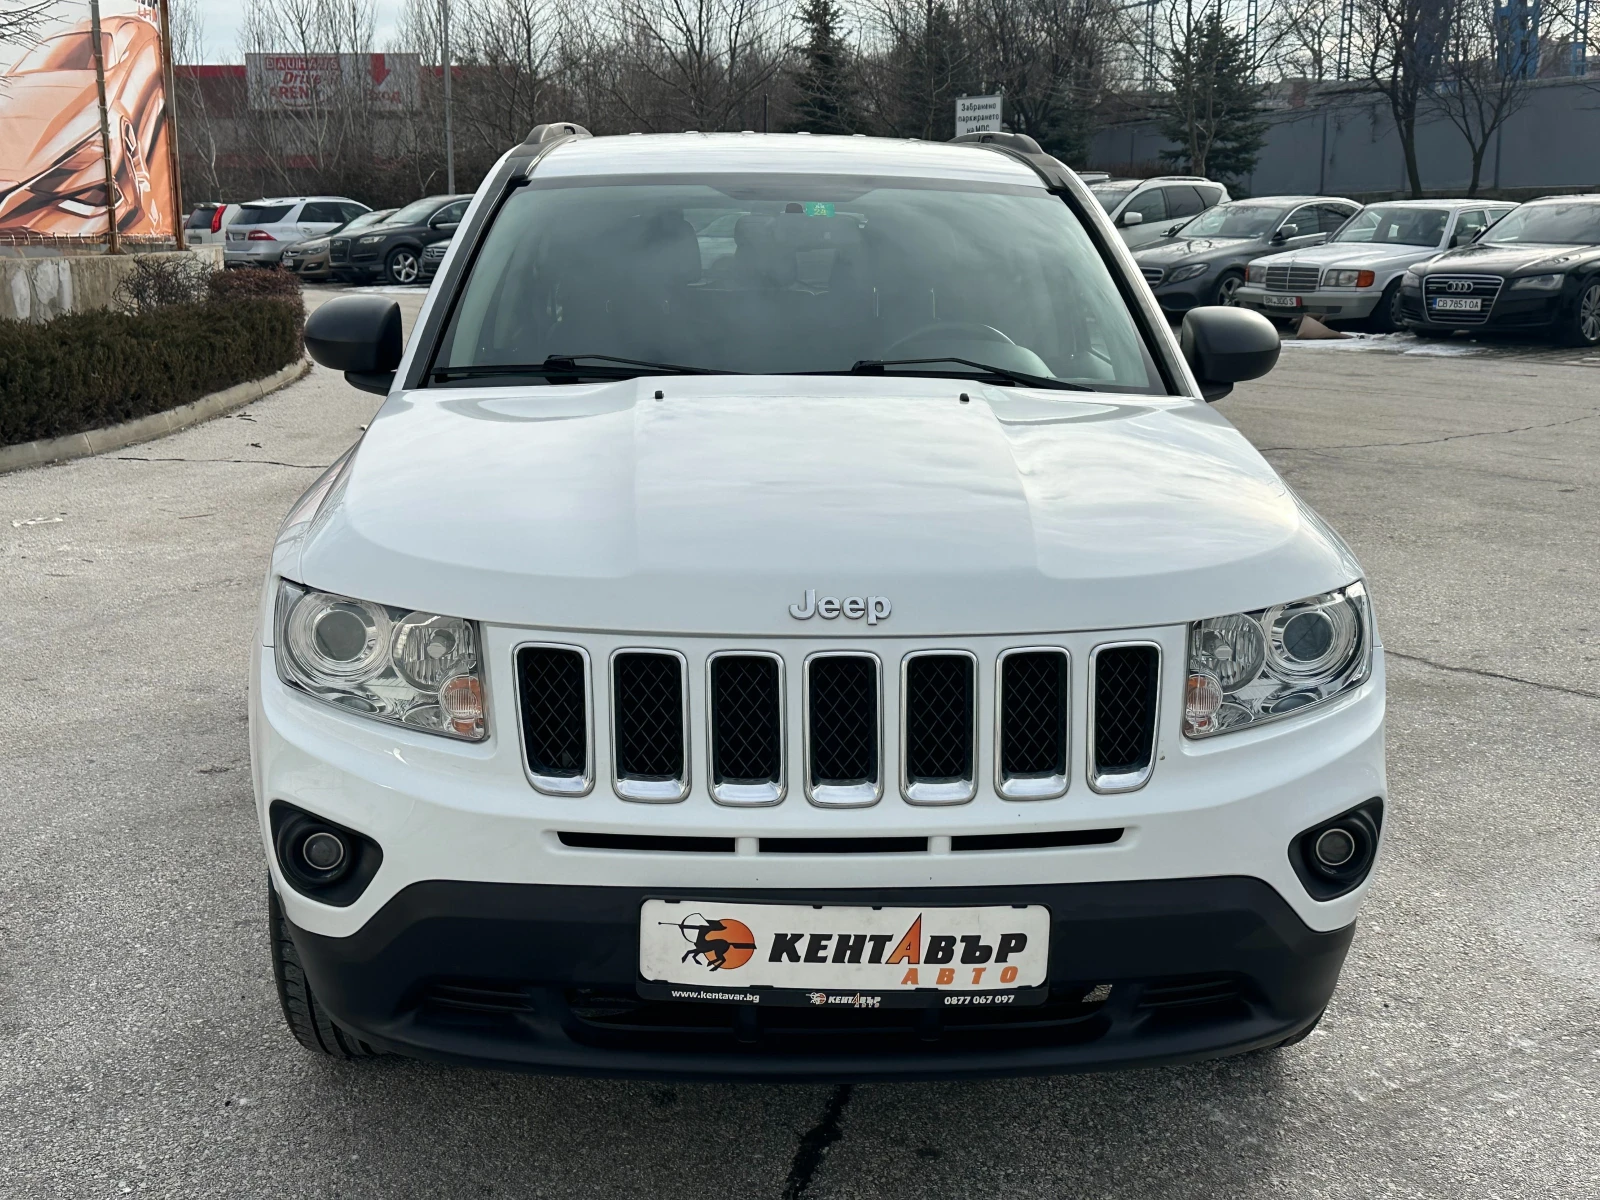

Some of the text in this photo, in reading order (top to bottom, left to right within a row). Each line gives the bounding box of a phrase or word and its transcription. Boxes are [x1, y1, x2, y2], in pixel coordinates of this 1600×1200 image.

[961, 103, 996, 112] Забранено
[958, 114, 999, 123] паркирането
[788, 589, 892, 625] Jeep
[768, 913, 1028, 964] КЕНТАВЪР
[671, 990, 760, 1003] www.kentavar.bg
[944, 994, 1015, 1005] 0877 067 097
